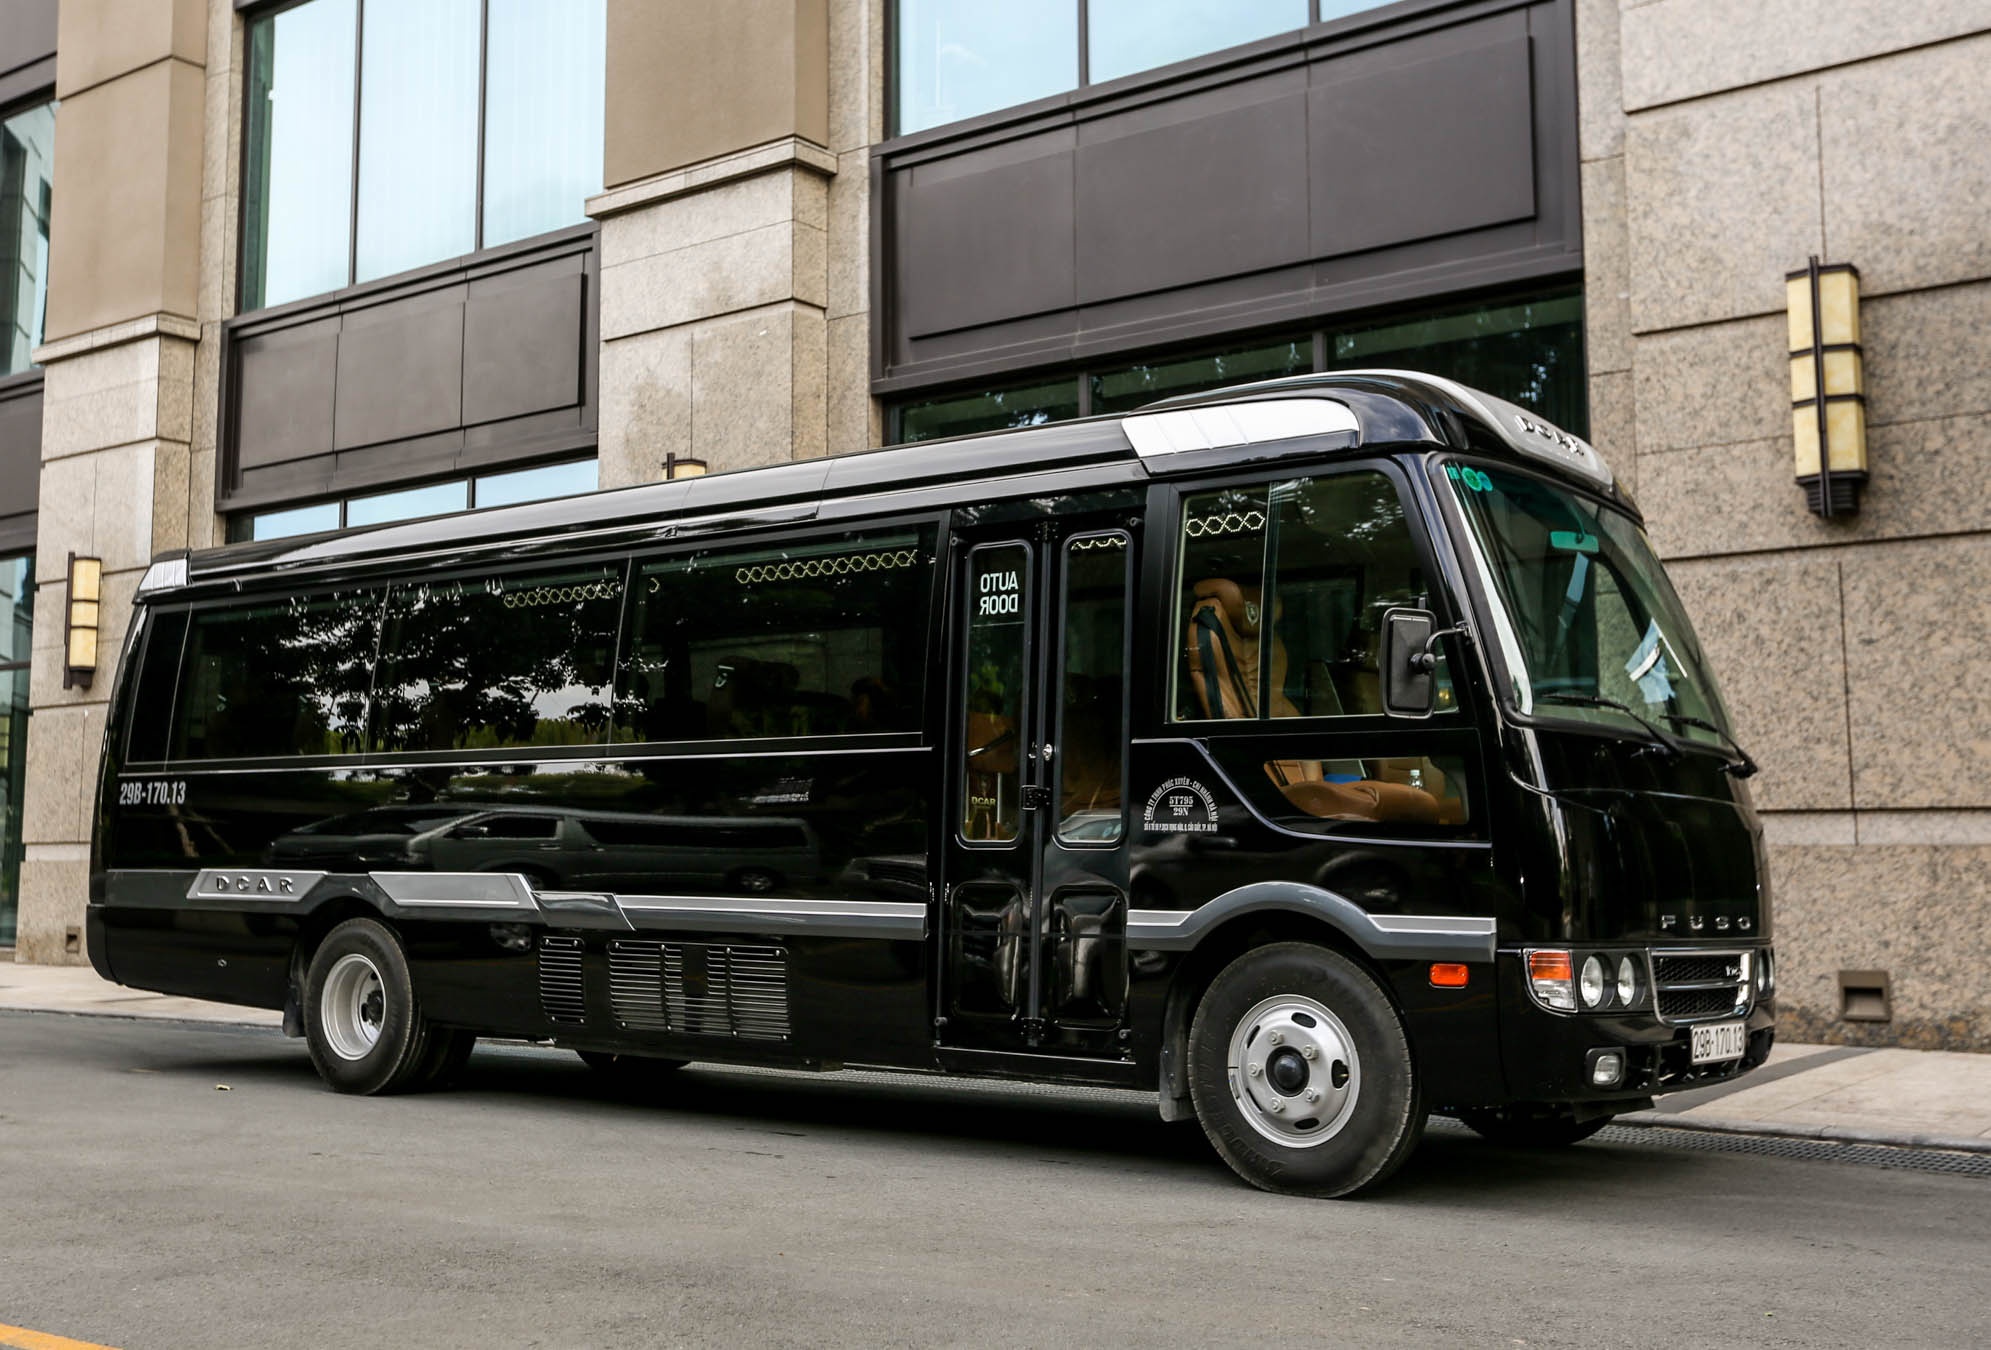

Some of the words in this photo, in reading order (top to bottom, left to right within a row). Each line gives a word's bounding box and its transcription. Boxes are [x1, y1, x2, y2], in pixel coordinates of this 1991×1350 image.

[119, 781, 187, 805] 29B-170.13
[1169, 796, 1194, 805] 5T795
[971, 796, 997, 806] DCAR
[1173, 807, 1189, 816] 29N
[216, 876, 294, 893] DCAR
[1661, 915, 1751, 930] FUSO
[1693, 1026, 1744, 1060] 29B-170.13
